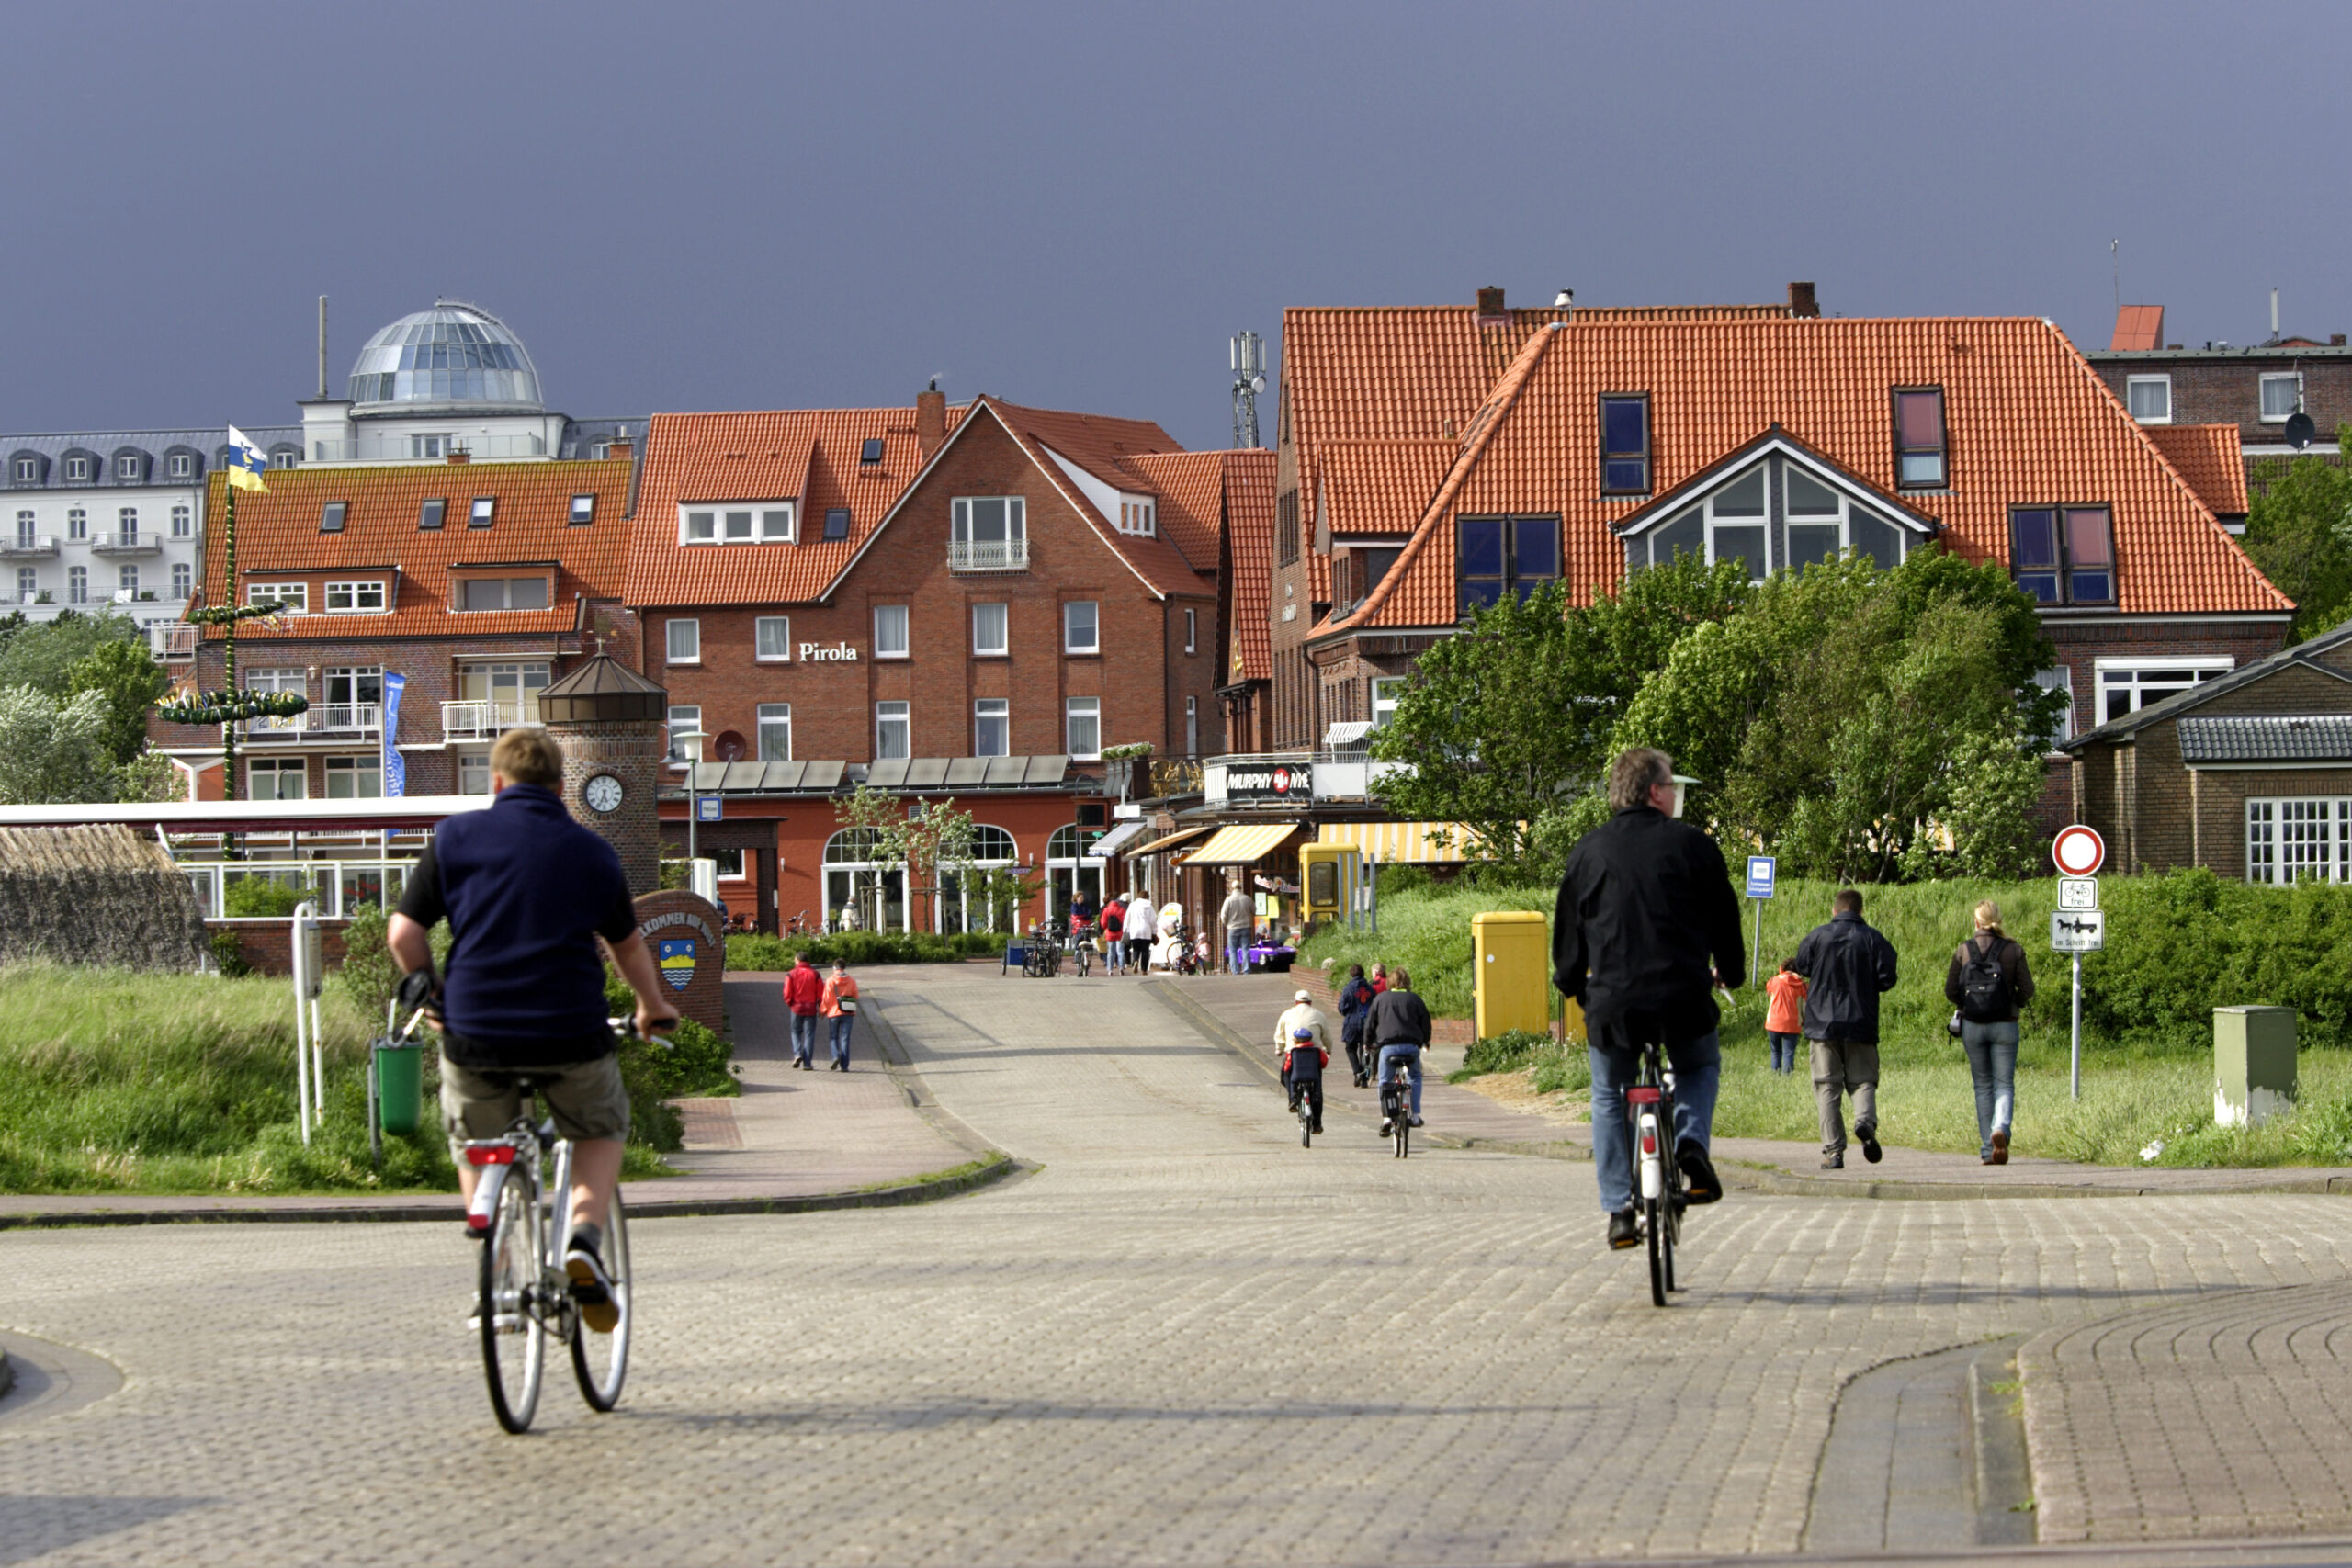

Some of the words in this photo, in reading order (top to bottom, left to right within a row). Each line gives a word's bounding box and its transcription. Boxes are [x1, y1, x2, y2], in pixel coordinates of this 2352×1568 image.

[799, 641, 857, 661] Pirola
[1227, 773, 1273, 789] MURPHY
[2071, 897, 2085, 906] frei
[638, 912, 686, 938] LKOMMEN
